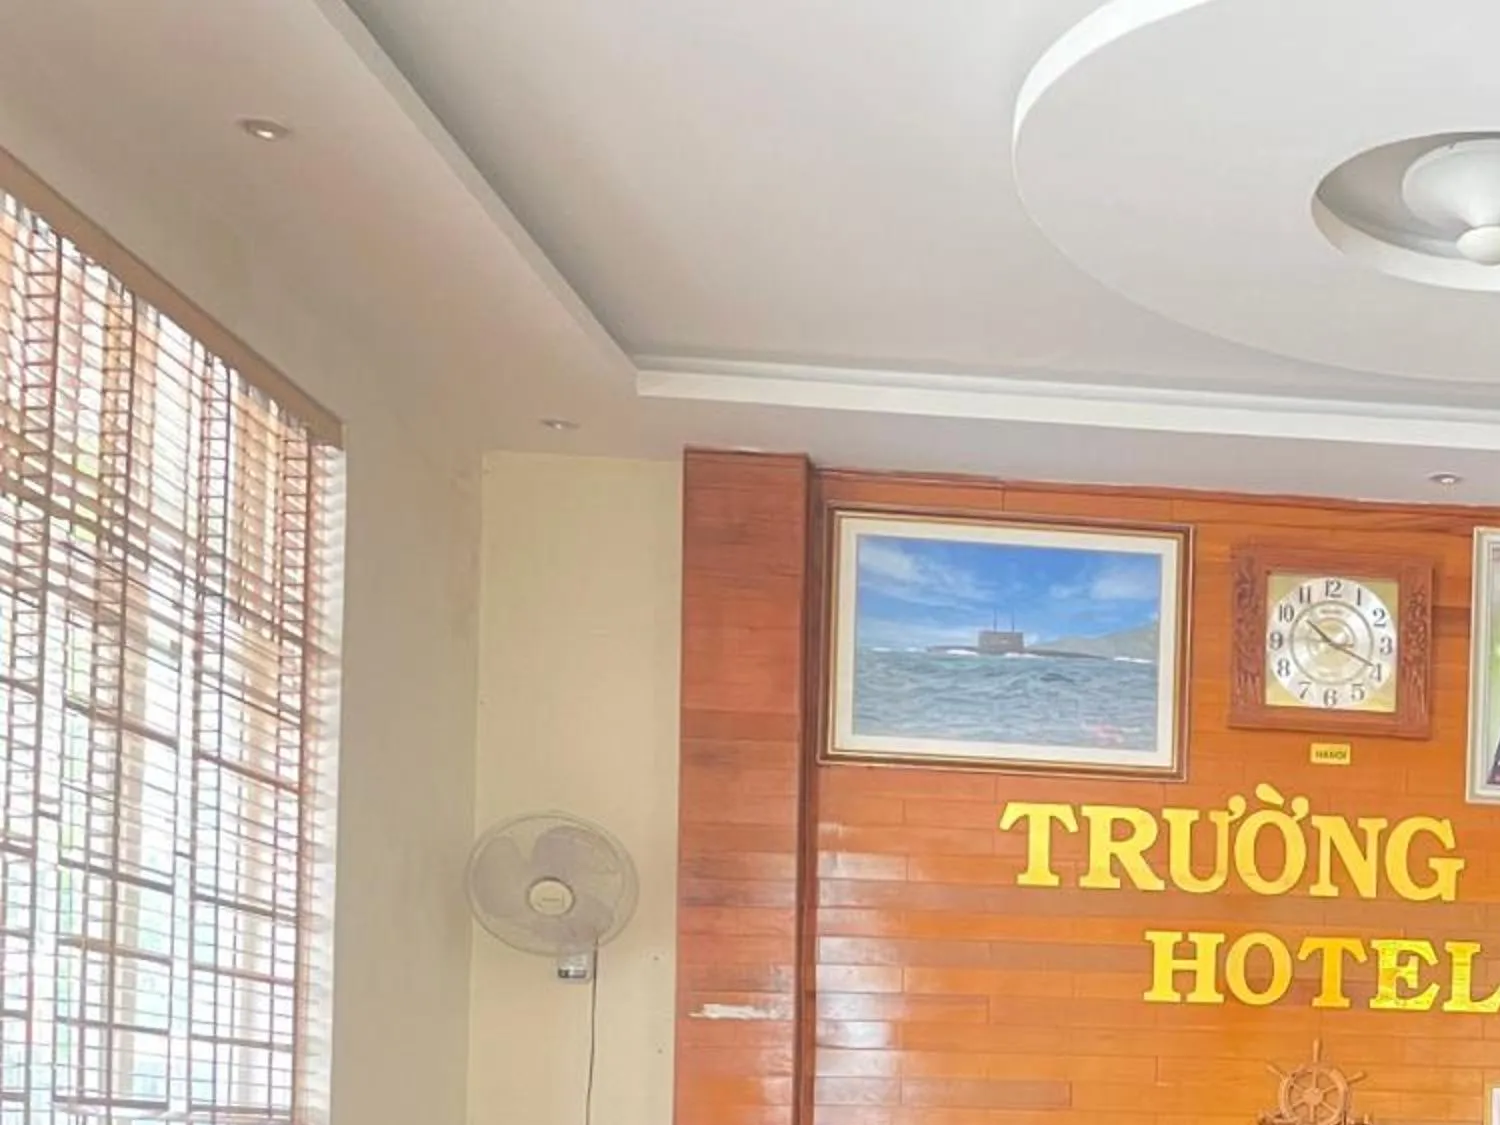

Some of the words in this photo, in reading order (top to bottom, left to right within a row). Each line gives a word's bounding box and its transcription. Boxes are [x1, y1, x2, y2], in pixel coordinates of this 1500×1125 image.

[1299, 585, 1311, 604] 11
[1325, 580, 1342, 598] 12
[1279, 603, 1294, 623] 10
[1372, 608, 1386, 627] 2
[1269, 632, 1283, 650] 9
[1380, 636, 1393, 655] 3
[1277, 657, 1290, 676] 8
[1368, 663, 1382, 681] 4
[1299, 681, 1312, 700] 7
[1323, 688, 1338, 706] 6
[1350, 683, 1365, 701] 5
[1000, 783, 1465, 901] TRƯỜNG
